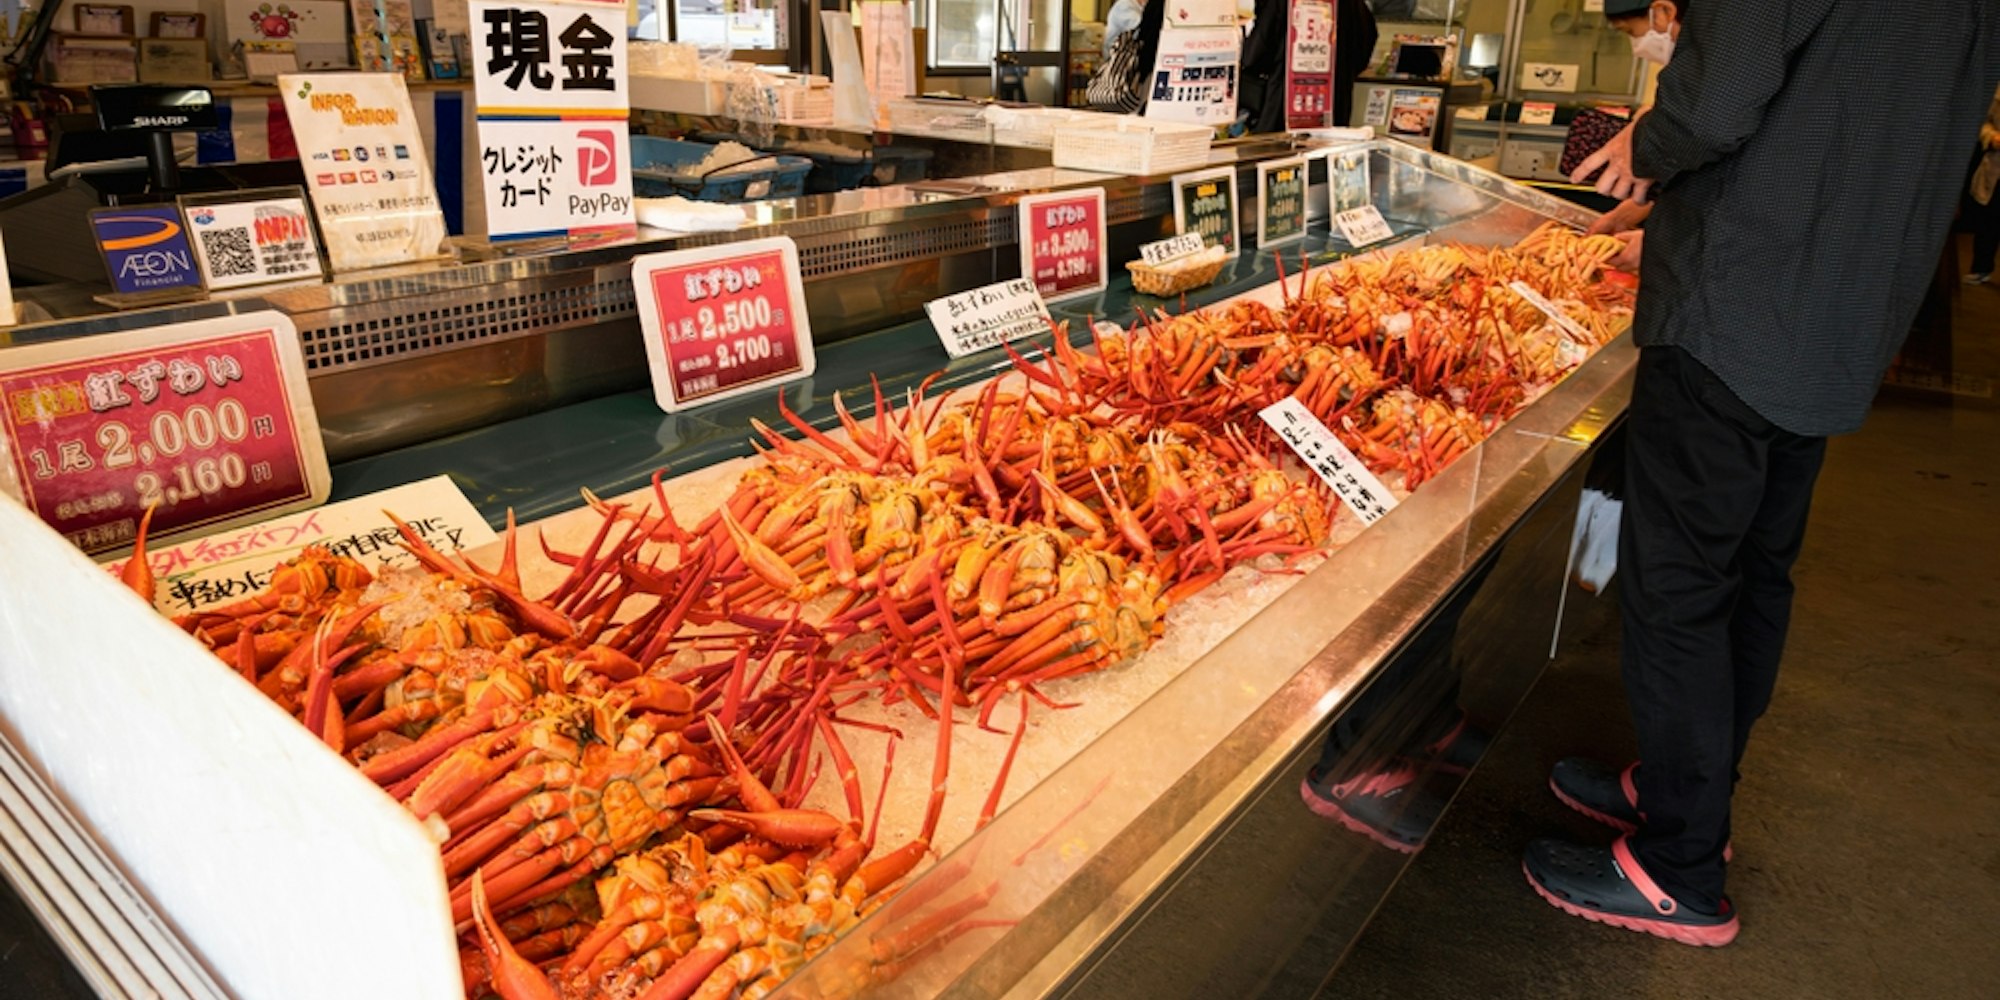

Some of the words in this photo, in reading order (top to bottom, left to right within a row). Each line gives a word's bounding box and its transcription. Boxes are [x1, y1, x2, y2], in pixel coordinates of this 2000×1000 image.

[483, 8, 617, 92] 現金
[133, 115, 189, 128] SHARP
[483, 145, 563, 175] クレジット
[501, 177, 552, 208] カード
[569, 193, 631, 218] PayPay
[85, 354, 244, 413] 紅ずわい
